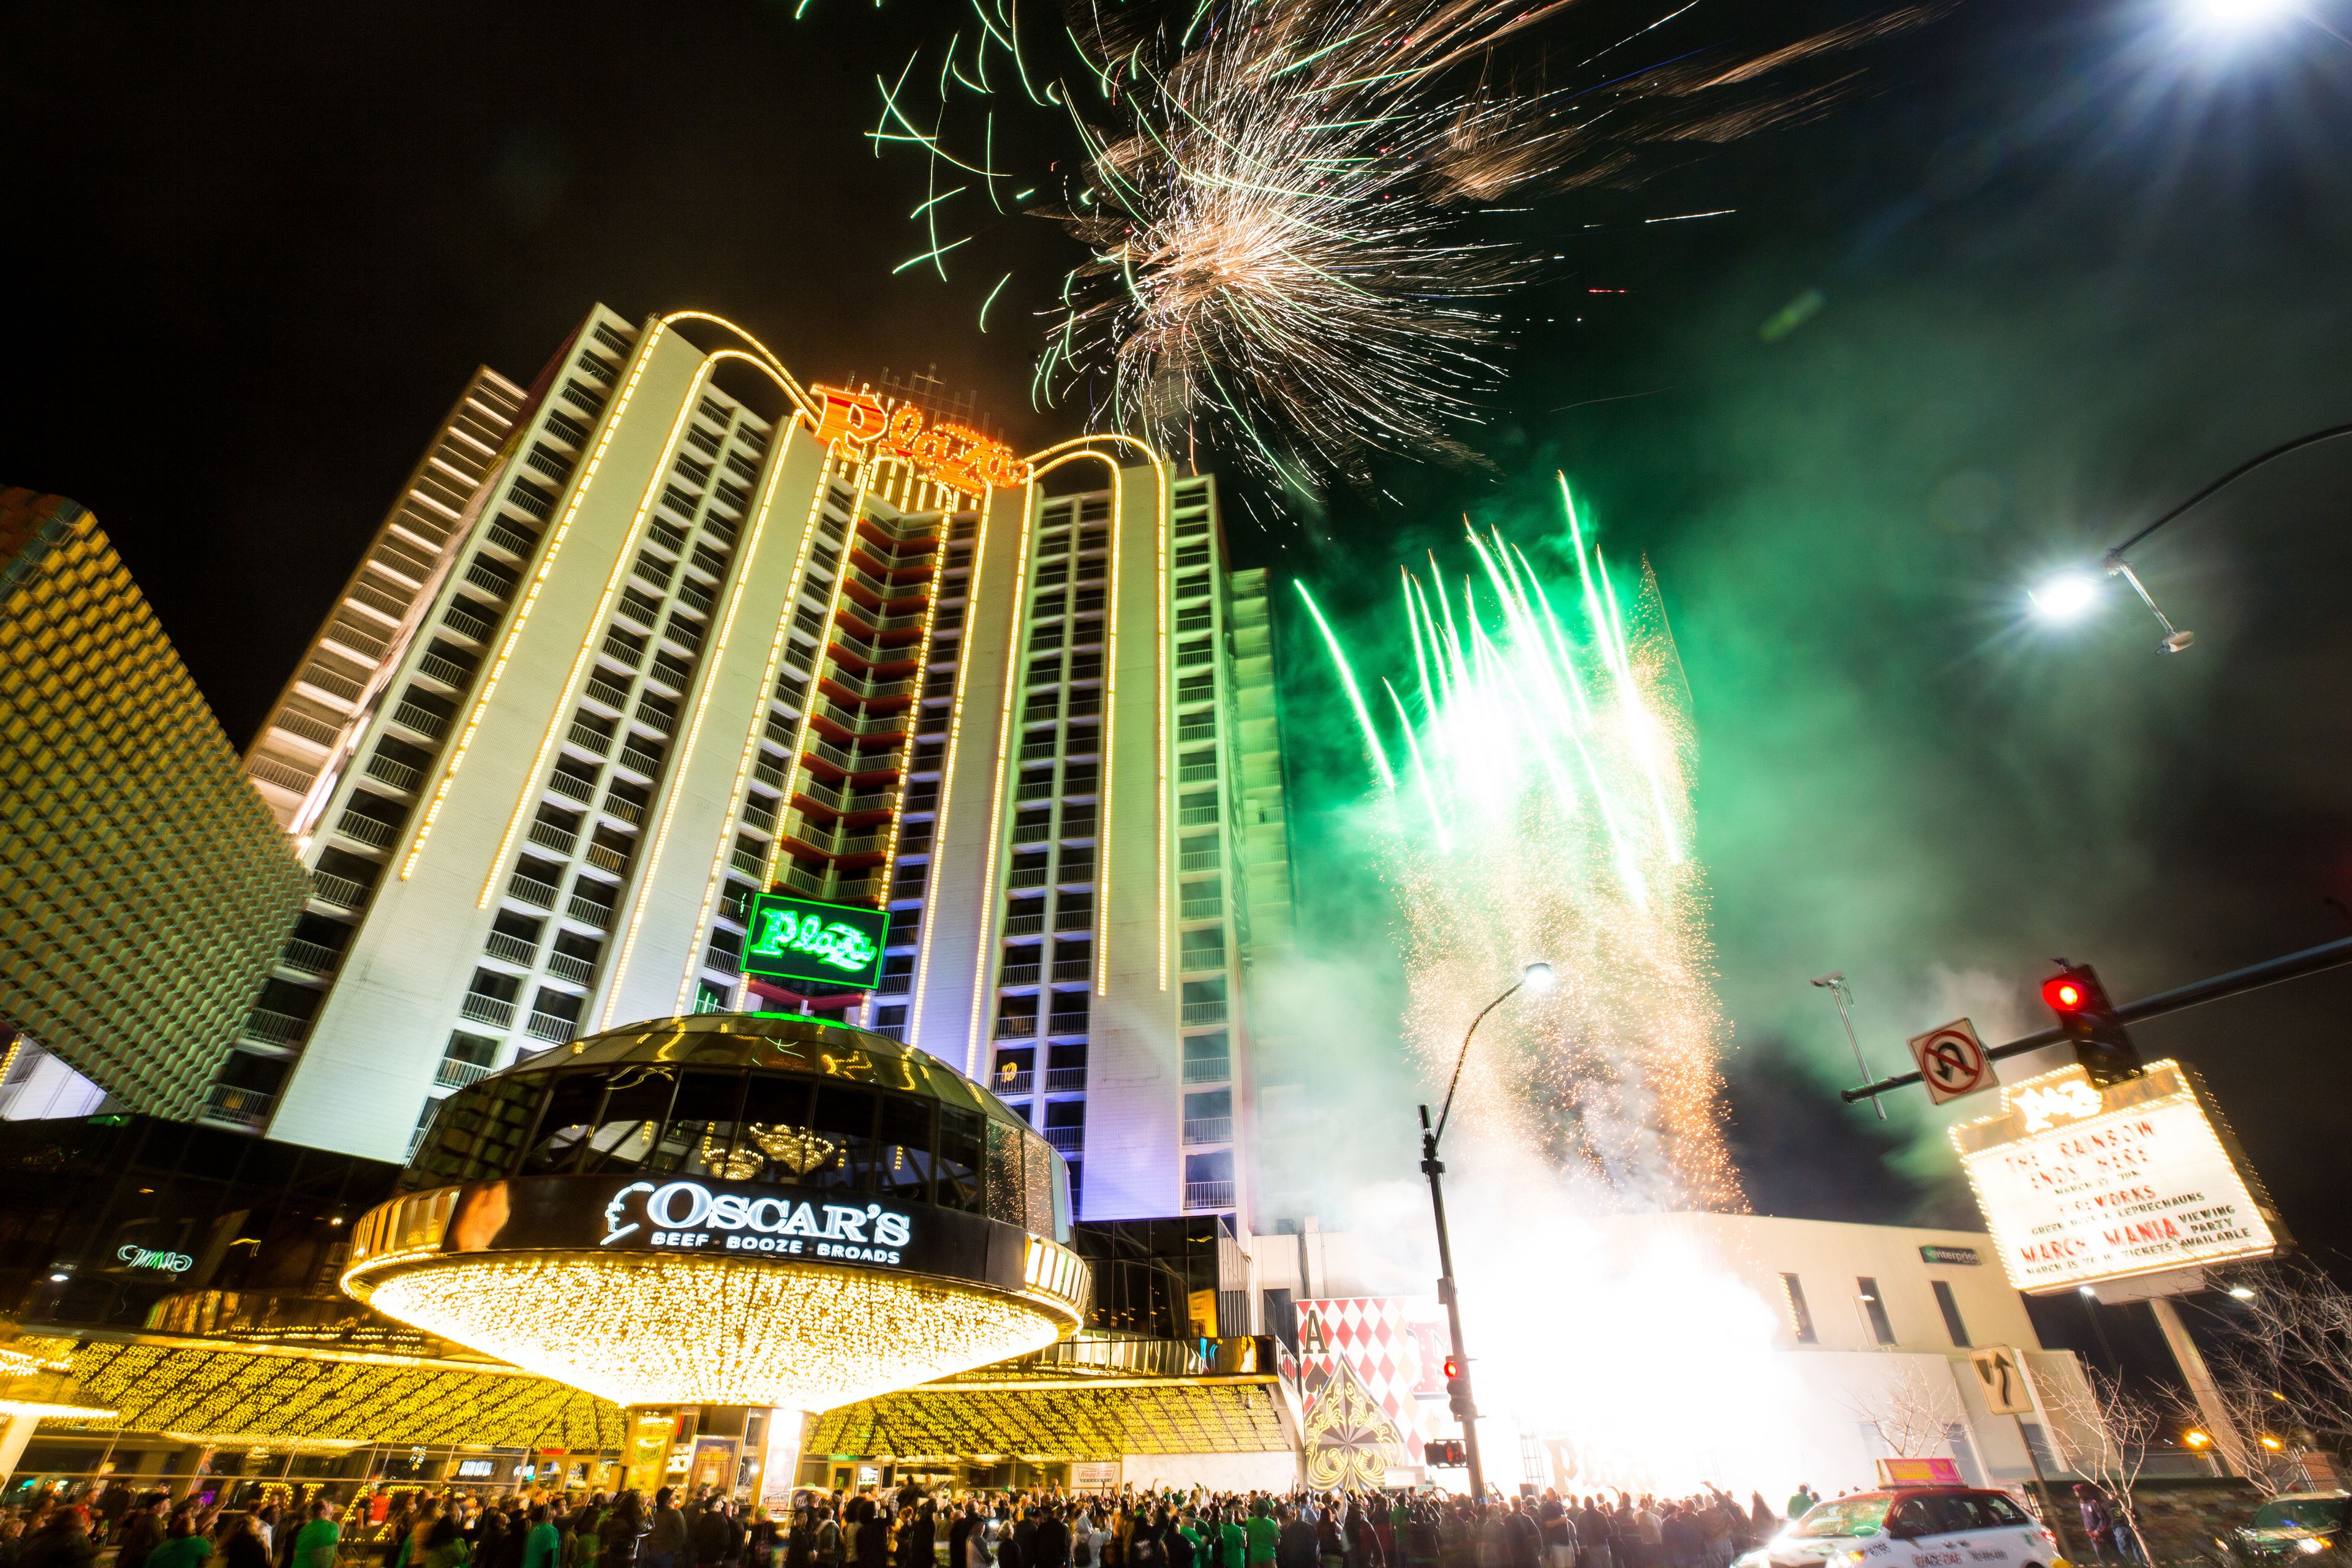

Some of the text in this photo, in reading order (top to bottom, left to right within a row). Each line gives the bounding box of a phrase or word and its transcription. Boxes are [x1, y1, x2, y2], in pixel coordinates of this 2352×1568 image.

[810, 383, 1021, 497] Plaza
[749, 907, 878, 973] Plaza
[2005, 1117, 2156, 1174] THE RAINBOW
[2028, 1145, 2153, 1190] ENDS HERE
[2054, 1182, 2094, 1196] MARCH
[2058, 1185, 2157, 1217] FIREWORKS
[646, 1182, 911, 1248] OSCAR'S
[2030, 1223, 2066, 1236] GREEN
[2117, 1191, 2206, 1218] LEPRECHAUNS
[2177, 1204, 2236, 1224] VIEWING
[2190, 1218, 2233, 1234] PARTY
[651, 1231, 901, 1265] BEEF BOOZE BROADS
[1927, 1250, 1979, 1262] enterprise
[2020, 1218, 2182, 1265] MARCH MANIA
[2026, 1262, 2064, 1275] MARCH
[2121, 1242, 2173, 1259] TICKETS
[2180, 1227, 2252, 1248] AVAILABLE
[1302, 1309, 1330, 1354] A
